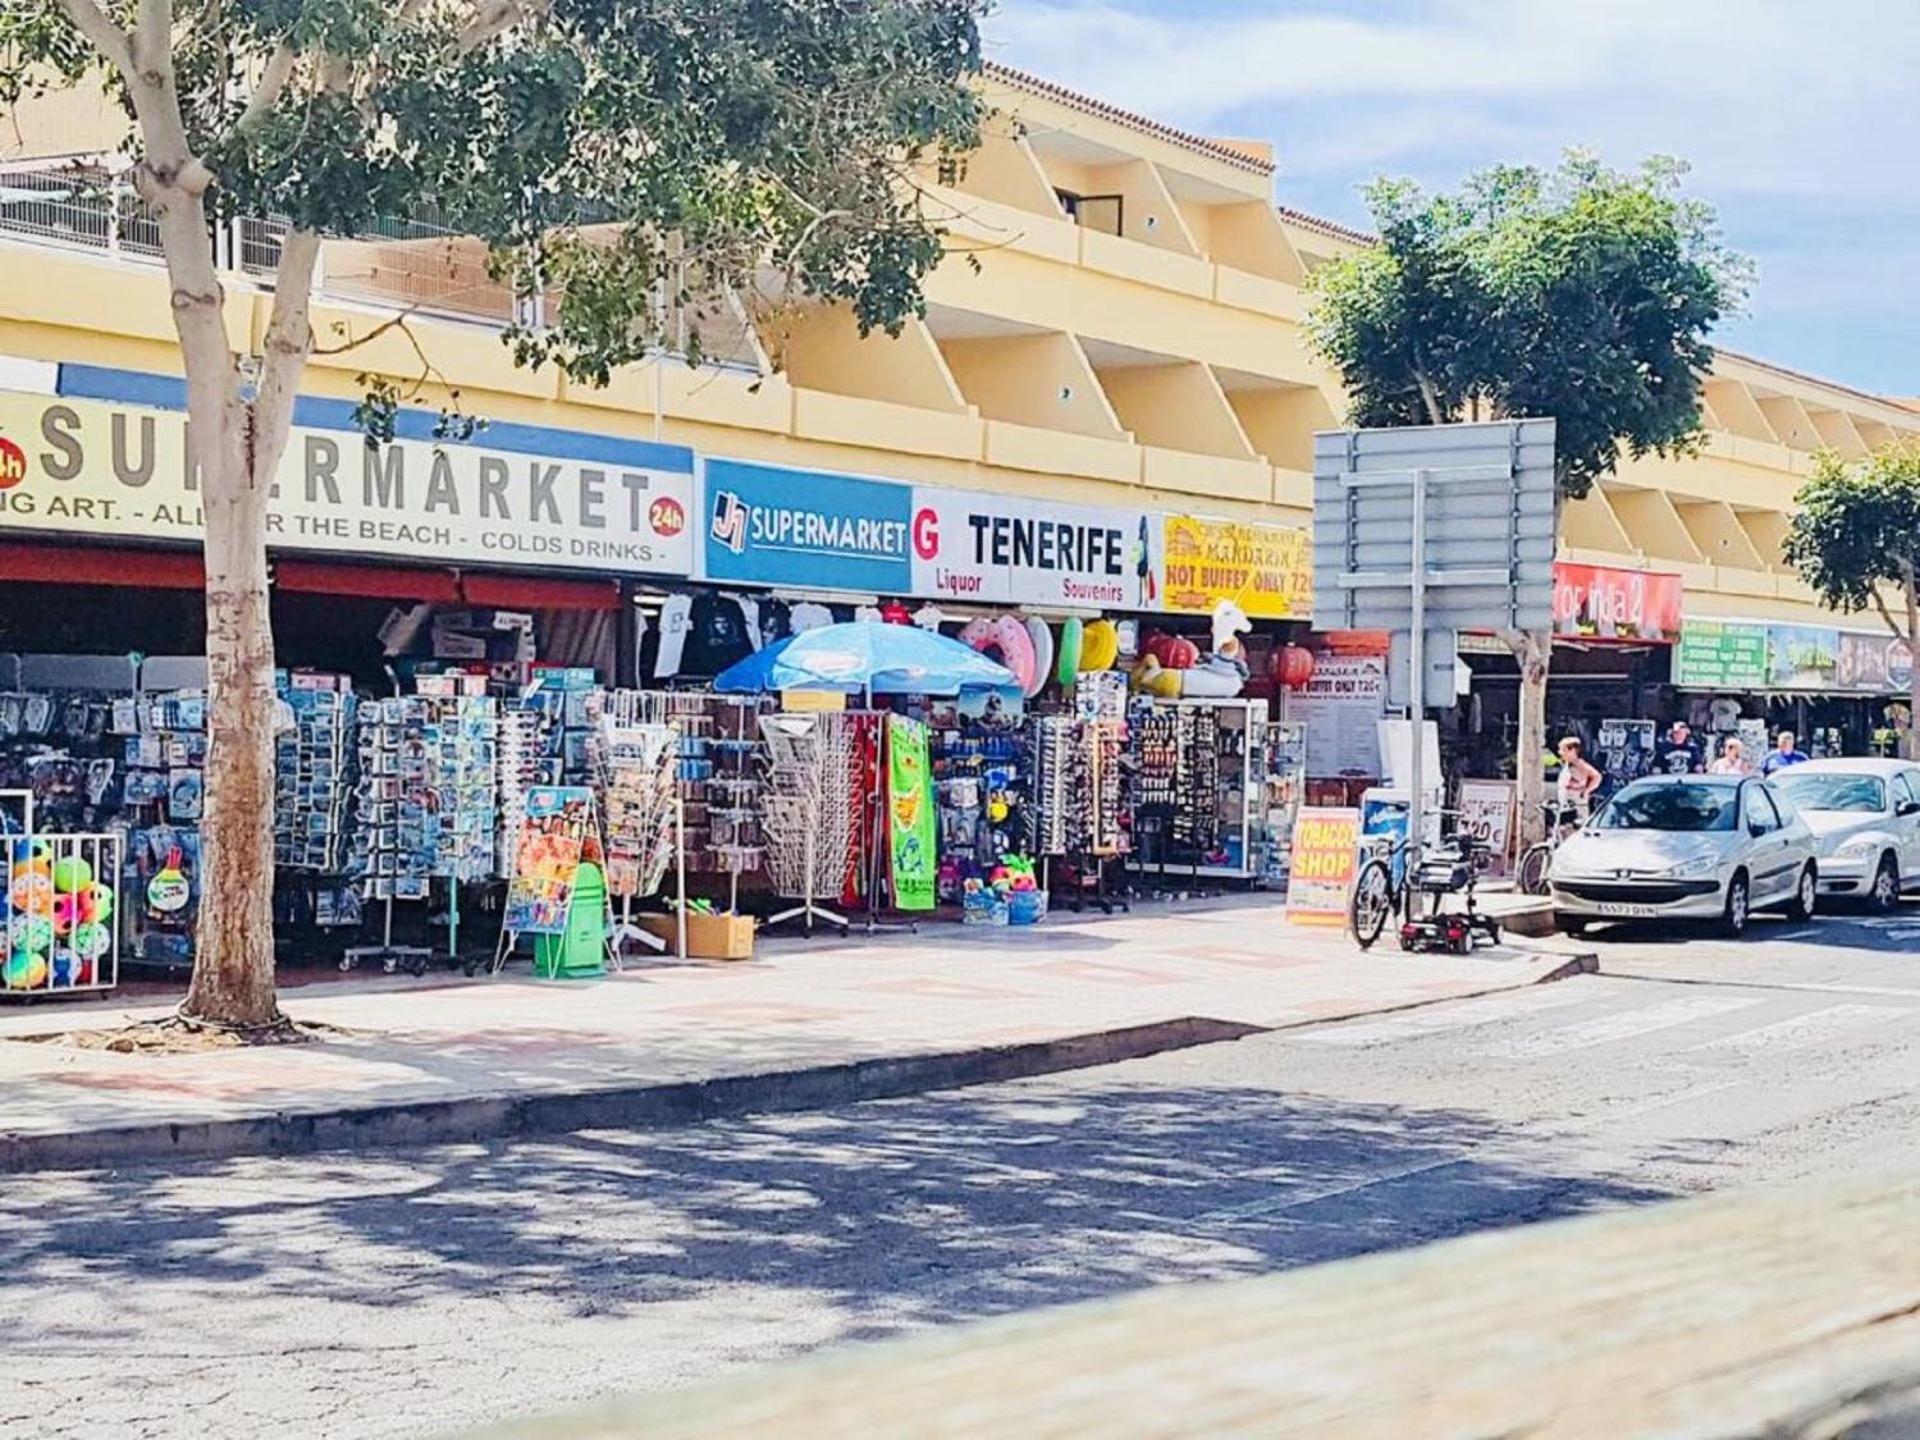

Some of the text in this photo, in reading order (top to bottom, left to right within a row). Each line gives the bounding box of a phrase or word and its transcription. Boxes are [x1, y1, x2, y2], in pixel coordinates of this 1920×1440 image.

[40, 405, 648, 531] SURMARKET
[46, 496, 121, 521] ART.
[652, 505, 682, 529] 24h
[293, 516, 350, 537] THE
[359, 520, 450, 545] BEACH
[481, 532, 563, 554] COLDS
[570, 539, 652, 562] DRINKS
[751, 506, 907, 554] SUPERMARKET
[913, 508, 939, 560] G
[968, 515, 1123, 575] TENERIFE
[936, 567, 982, 596] Liquor
[1062, 578, 1124, 602] Souvenirs
[1166, 564, 1197, 587] HOT
[1202, 567, 1249, 590] BUFFET
[1254, 571, 1286, 594] ONLY
[1295, 851, 1351, 877] SHOP
